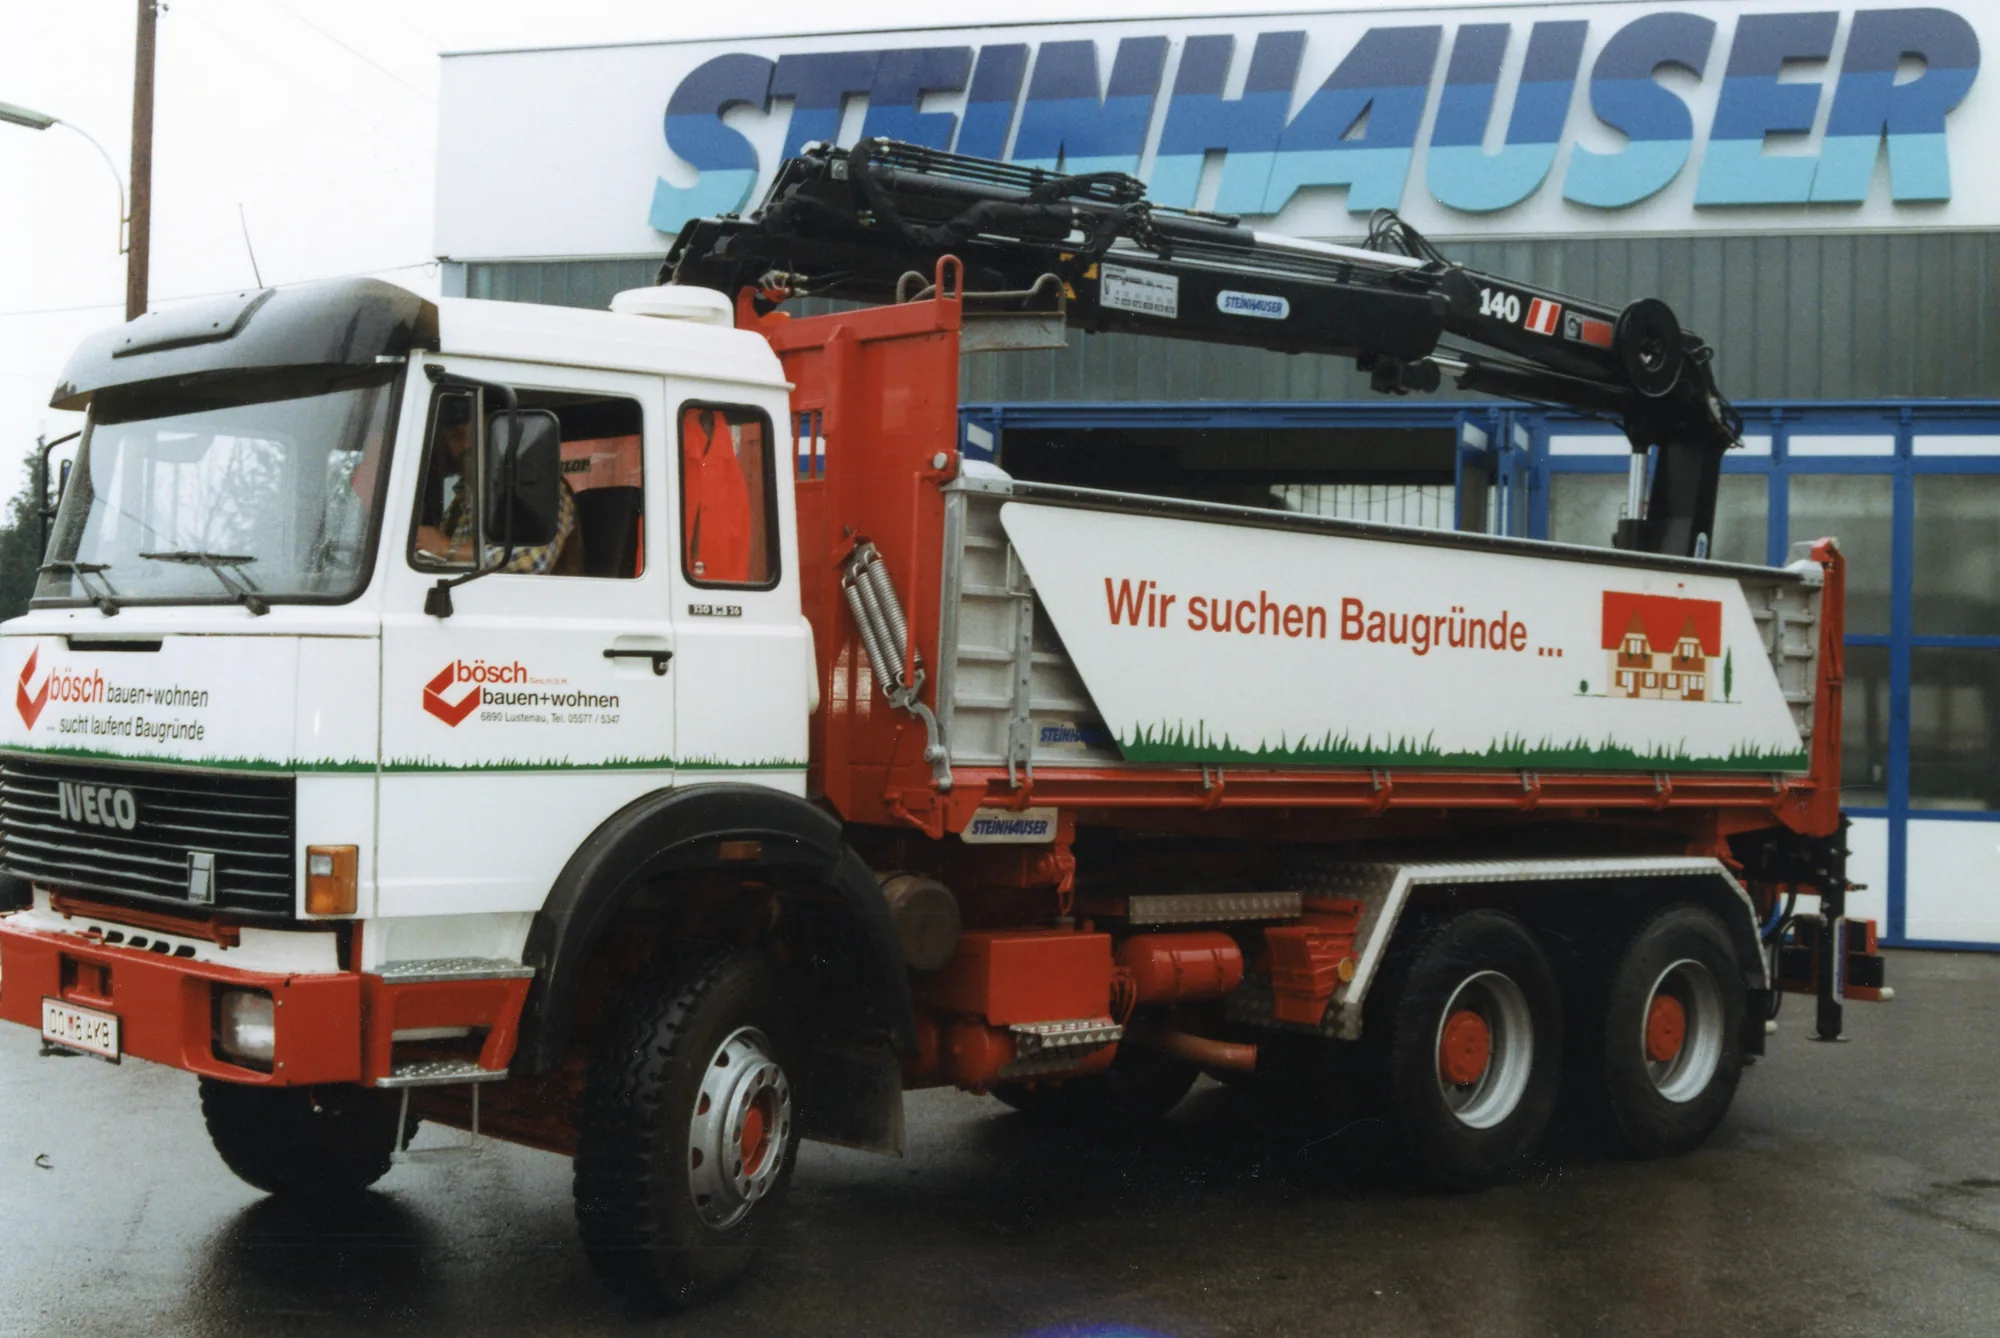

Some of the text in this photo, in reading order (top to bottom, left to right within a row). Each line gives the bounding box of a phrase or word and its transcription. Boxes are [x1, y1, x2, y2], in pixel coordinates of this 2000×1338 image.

[648, 6, 1980, 236] STEINHAUSER
[1225, 295, 1283, 313] STEINHAUSER
[1479, 287, 1521, 323] 140
[1104, 577, 1176, 628] Wir
[1187, 589, 1327, 640] suchen
[1341, 597, 1528, 657] Baugründe
[457, 660, 528, 684] bösch
[50, 667, 209, 708] bösch bauen+wohnen
[482, 687, 620, 708] bauen+wohnen
[60, 714, 88, 735] sucht
[91, 715, 133, 737] laufend
[135, 716, 205, 744] Baugründe
[551, 712, 566, 724] Tel.
[58, 781, 137, 830] IVECO
[972, 818, 1049, 836] STEINHAUSER
